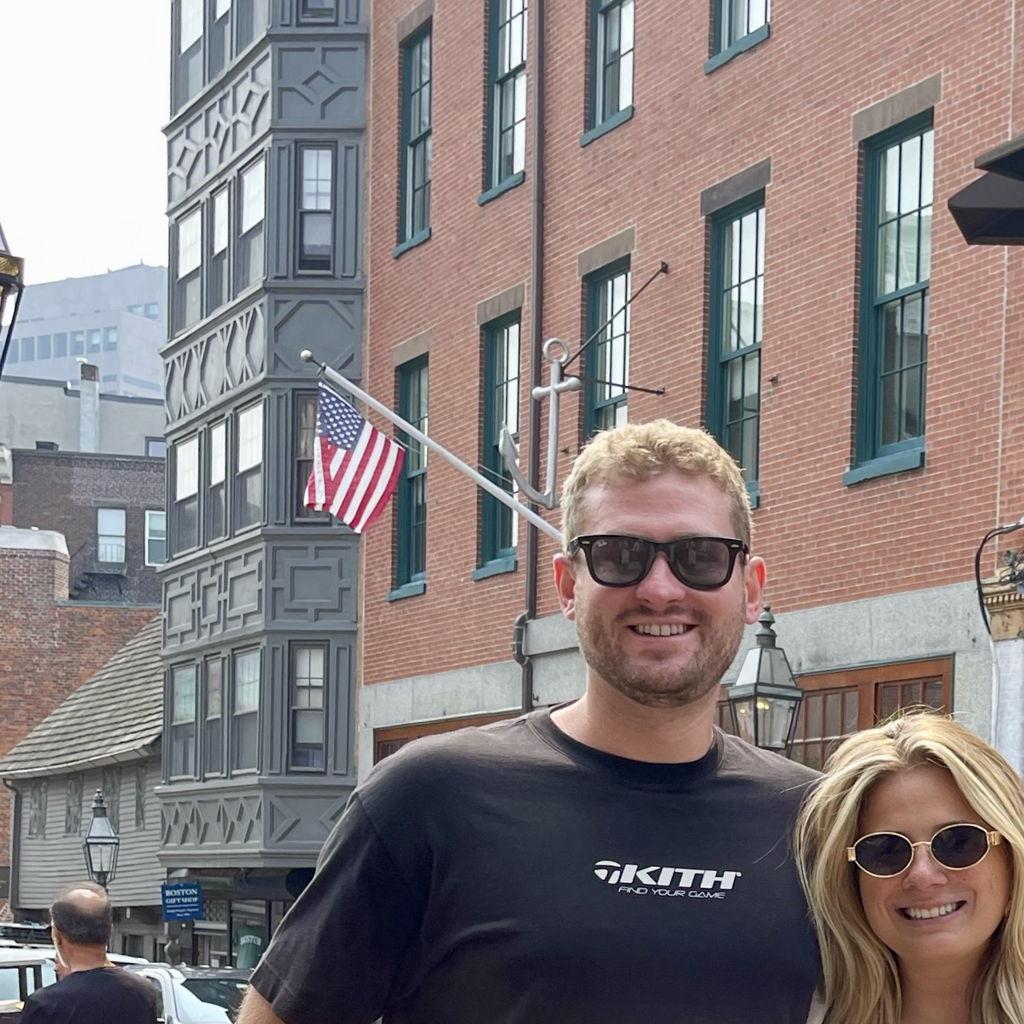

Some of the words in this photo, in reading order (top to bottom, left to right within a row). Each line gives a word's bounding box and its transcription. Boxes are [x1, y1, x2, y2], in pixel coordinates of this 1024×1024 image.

[619, 863, 737, 890] KITH
[165, 888, 198, 897] BOSTON
[618, 885, 648, 895] FIND
[651, 888, 686, 897] YOUR
[688, 890, 726, 899] GAME
